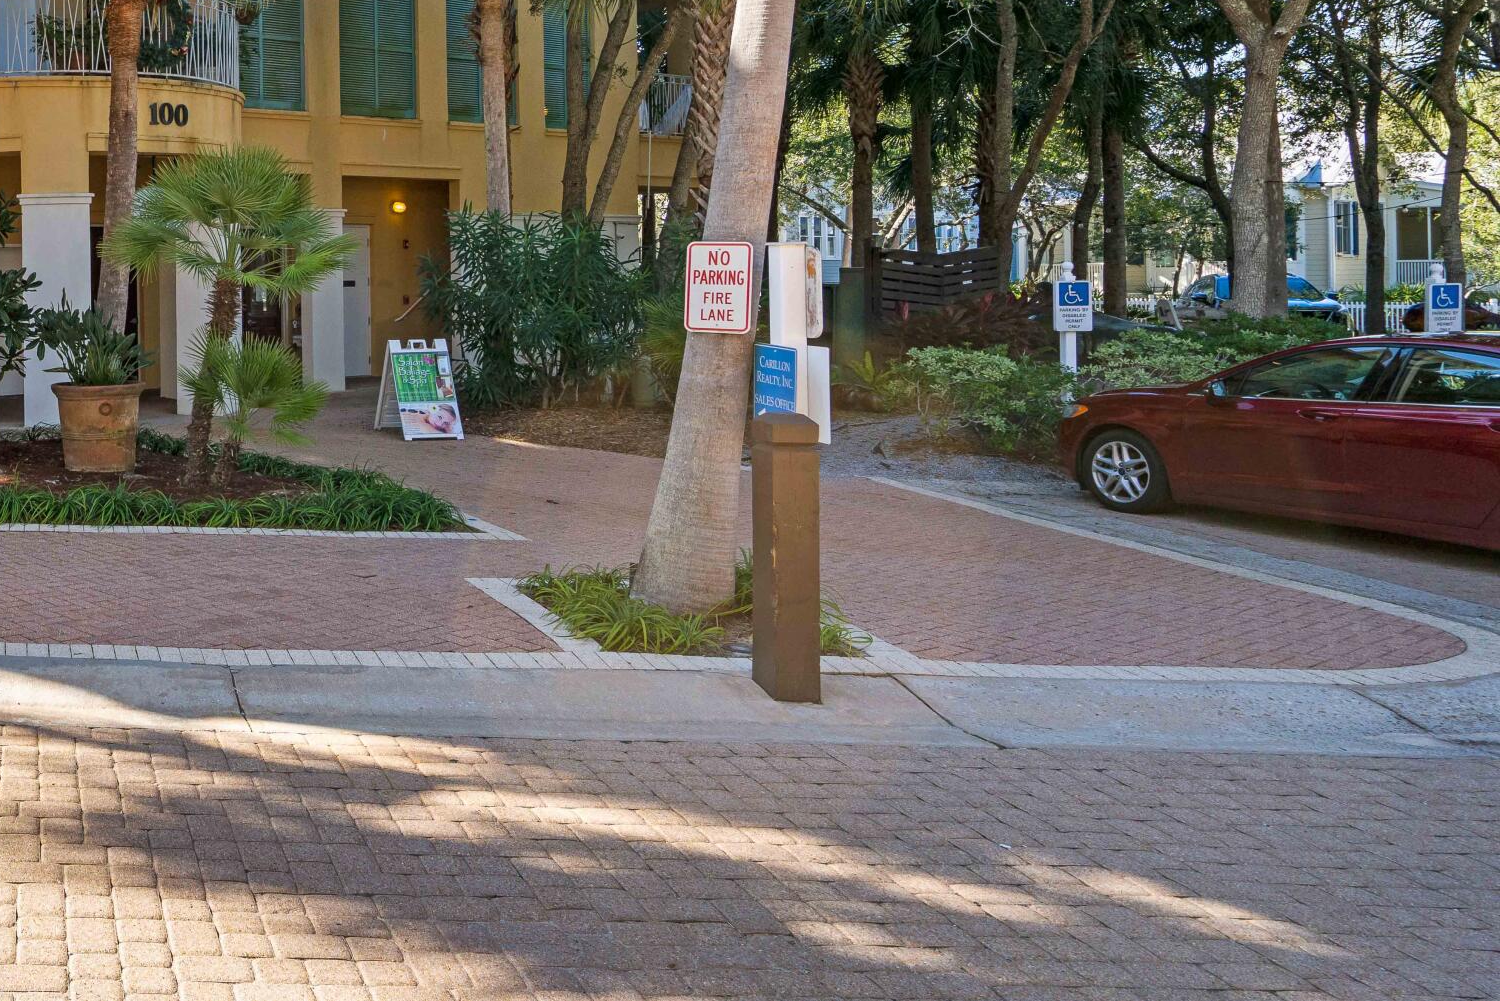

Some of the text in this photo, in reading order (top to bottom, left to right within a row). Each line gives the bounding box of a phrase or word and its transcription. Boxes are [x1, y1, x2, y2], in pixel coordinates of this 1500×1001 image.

[149, 102, 189, 127] 100
[708, 250, 731, 266] NO
[693, 269, 745, 286] PARKING
[703, 291, 733, 305] FIRE
[700, 308, 735, 322] LANE
[398, 356, 424, 367] Salon
[755, 393, 775, 407] SALES
